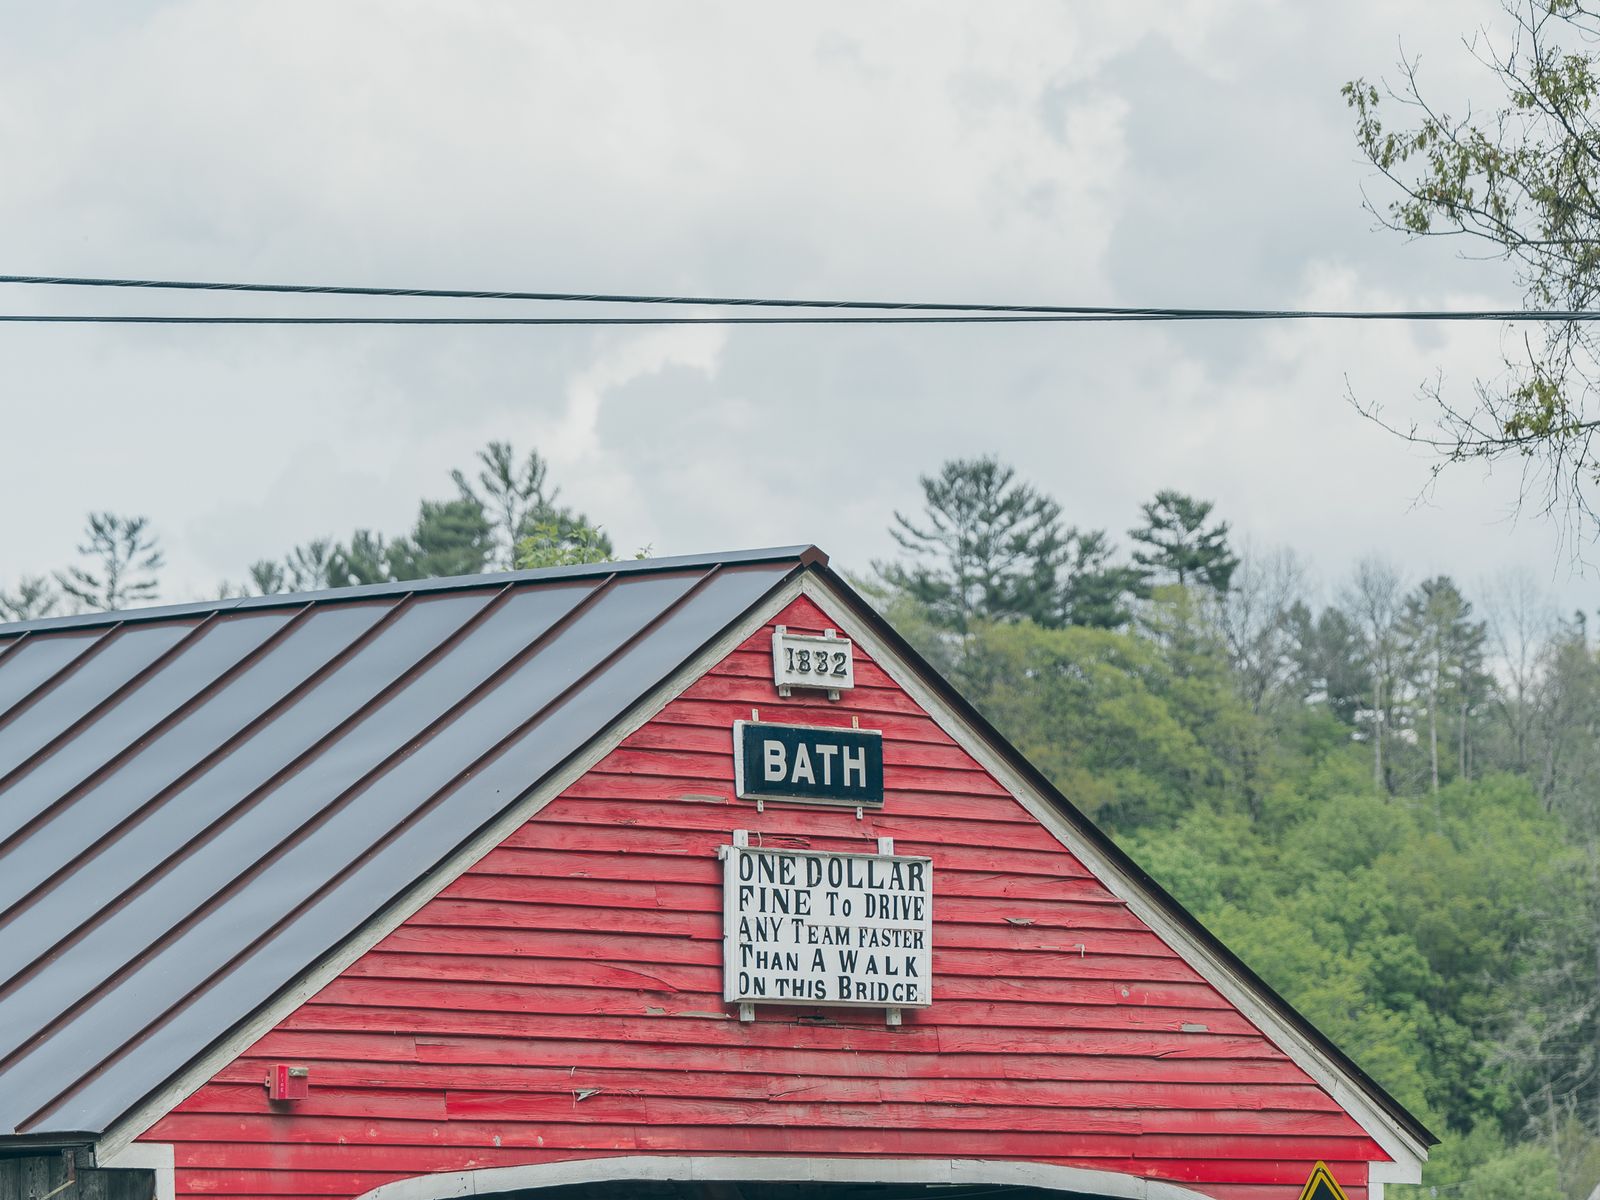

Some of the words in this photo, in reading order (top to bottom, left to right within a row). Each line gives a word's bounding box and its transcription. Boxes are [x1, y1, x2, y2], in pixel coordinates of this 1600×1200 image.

[785, 648, 847, 676] 1832
[763, 740, 866, 787] BATH
[739, 853, 796, 886] ONE
[806, 856, 925, 892] DOLLAR
[739, 885, 811, 916] FINE
[864, 892, 925, 921] DRIVE
[739, 916, 783, 943] ANY
[858, 926, 924, 950] FASTER
[811, 948, 826, 973] A
[775, 978, 827, 1000] THIS
